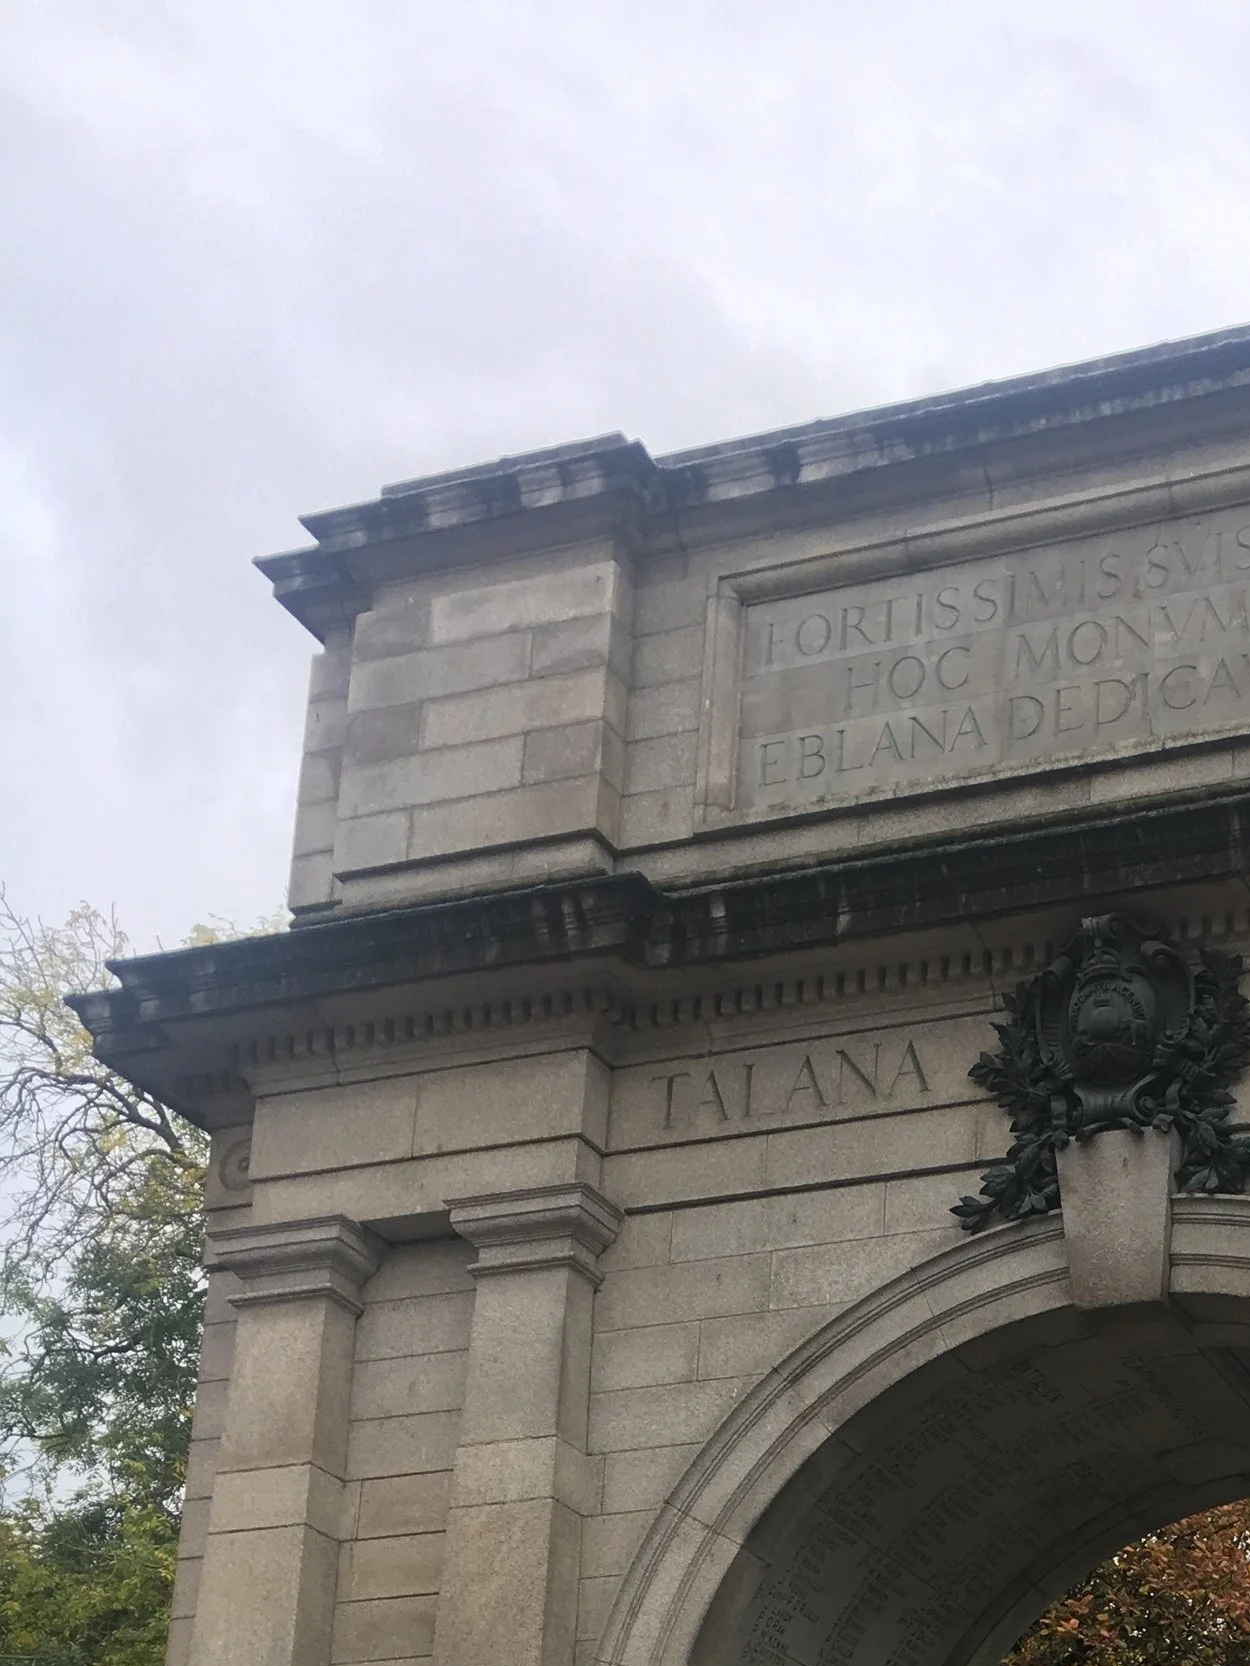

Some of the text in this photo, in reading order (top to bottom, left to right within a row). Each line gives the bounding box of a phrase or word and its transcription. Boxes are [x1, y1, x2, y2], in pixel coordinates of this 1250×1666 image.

[764, 554, 1122, 665] FORTISSIMIS
[846, 646, 971, 710] HOC
[758, 705, 990, 787] EBLANA
[651, 1039, 930, 1130] TALANA
